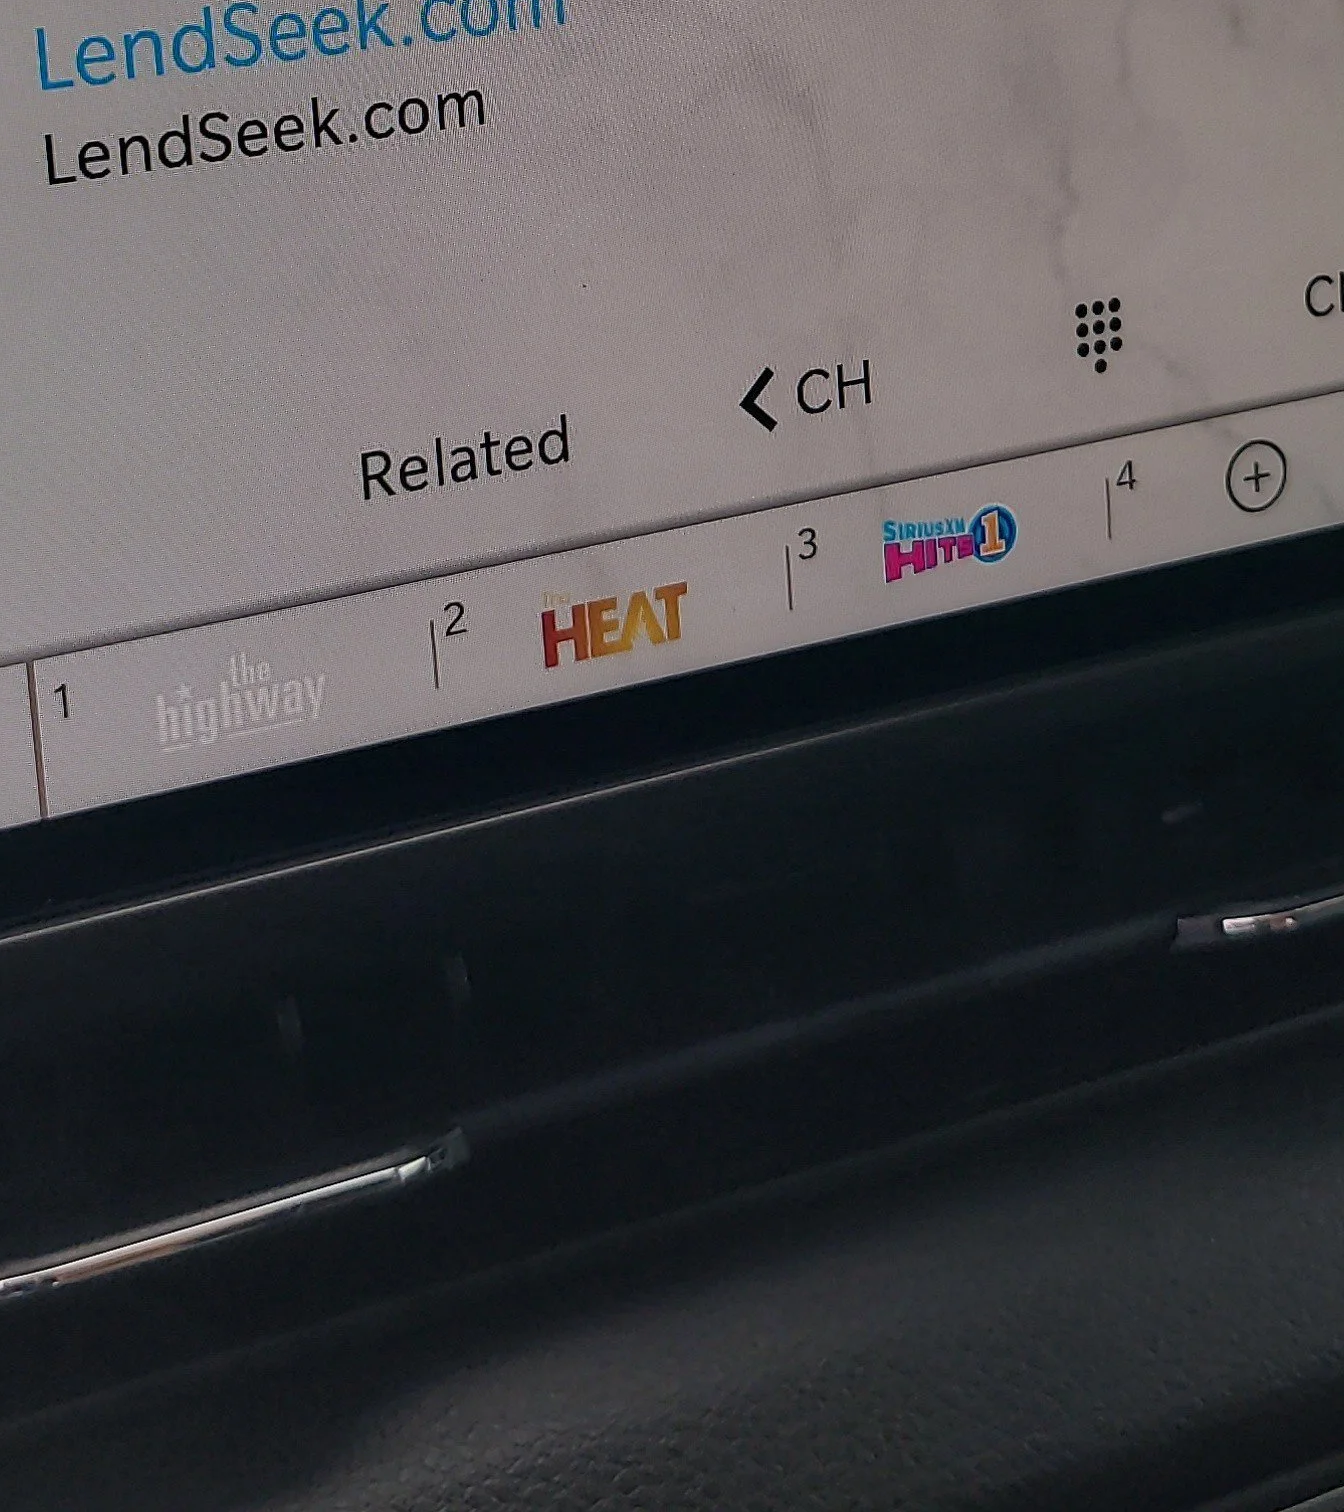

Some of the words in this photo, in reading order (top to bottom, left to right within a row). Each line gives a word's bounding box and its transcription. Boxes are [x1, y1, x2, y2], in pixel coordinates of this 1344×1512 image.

[43, 86, 487, 186] LendSeek.com
[796, 359, 873, 415] CH
[360, 413, 571, 500] Related
[1116, 459, 1138, 493] 4
[796, 527, 819, 561] 3
[884, 534, 974, 583] HITS
[979, 509, 1006, 557] 1
[441, 600, 469, 636] 2
[541, 580, 688, 668] HEAT
[230, 651, 272, 688] the
[52, 682, 71, 719] 1
[156, 673, 326, 745] highway
